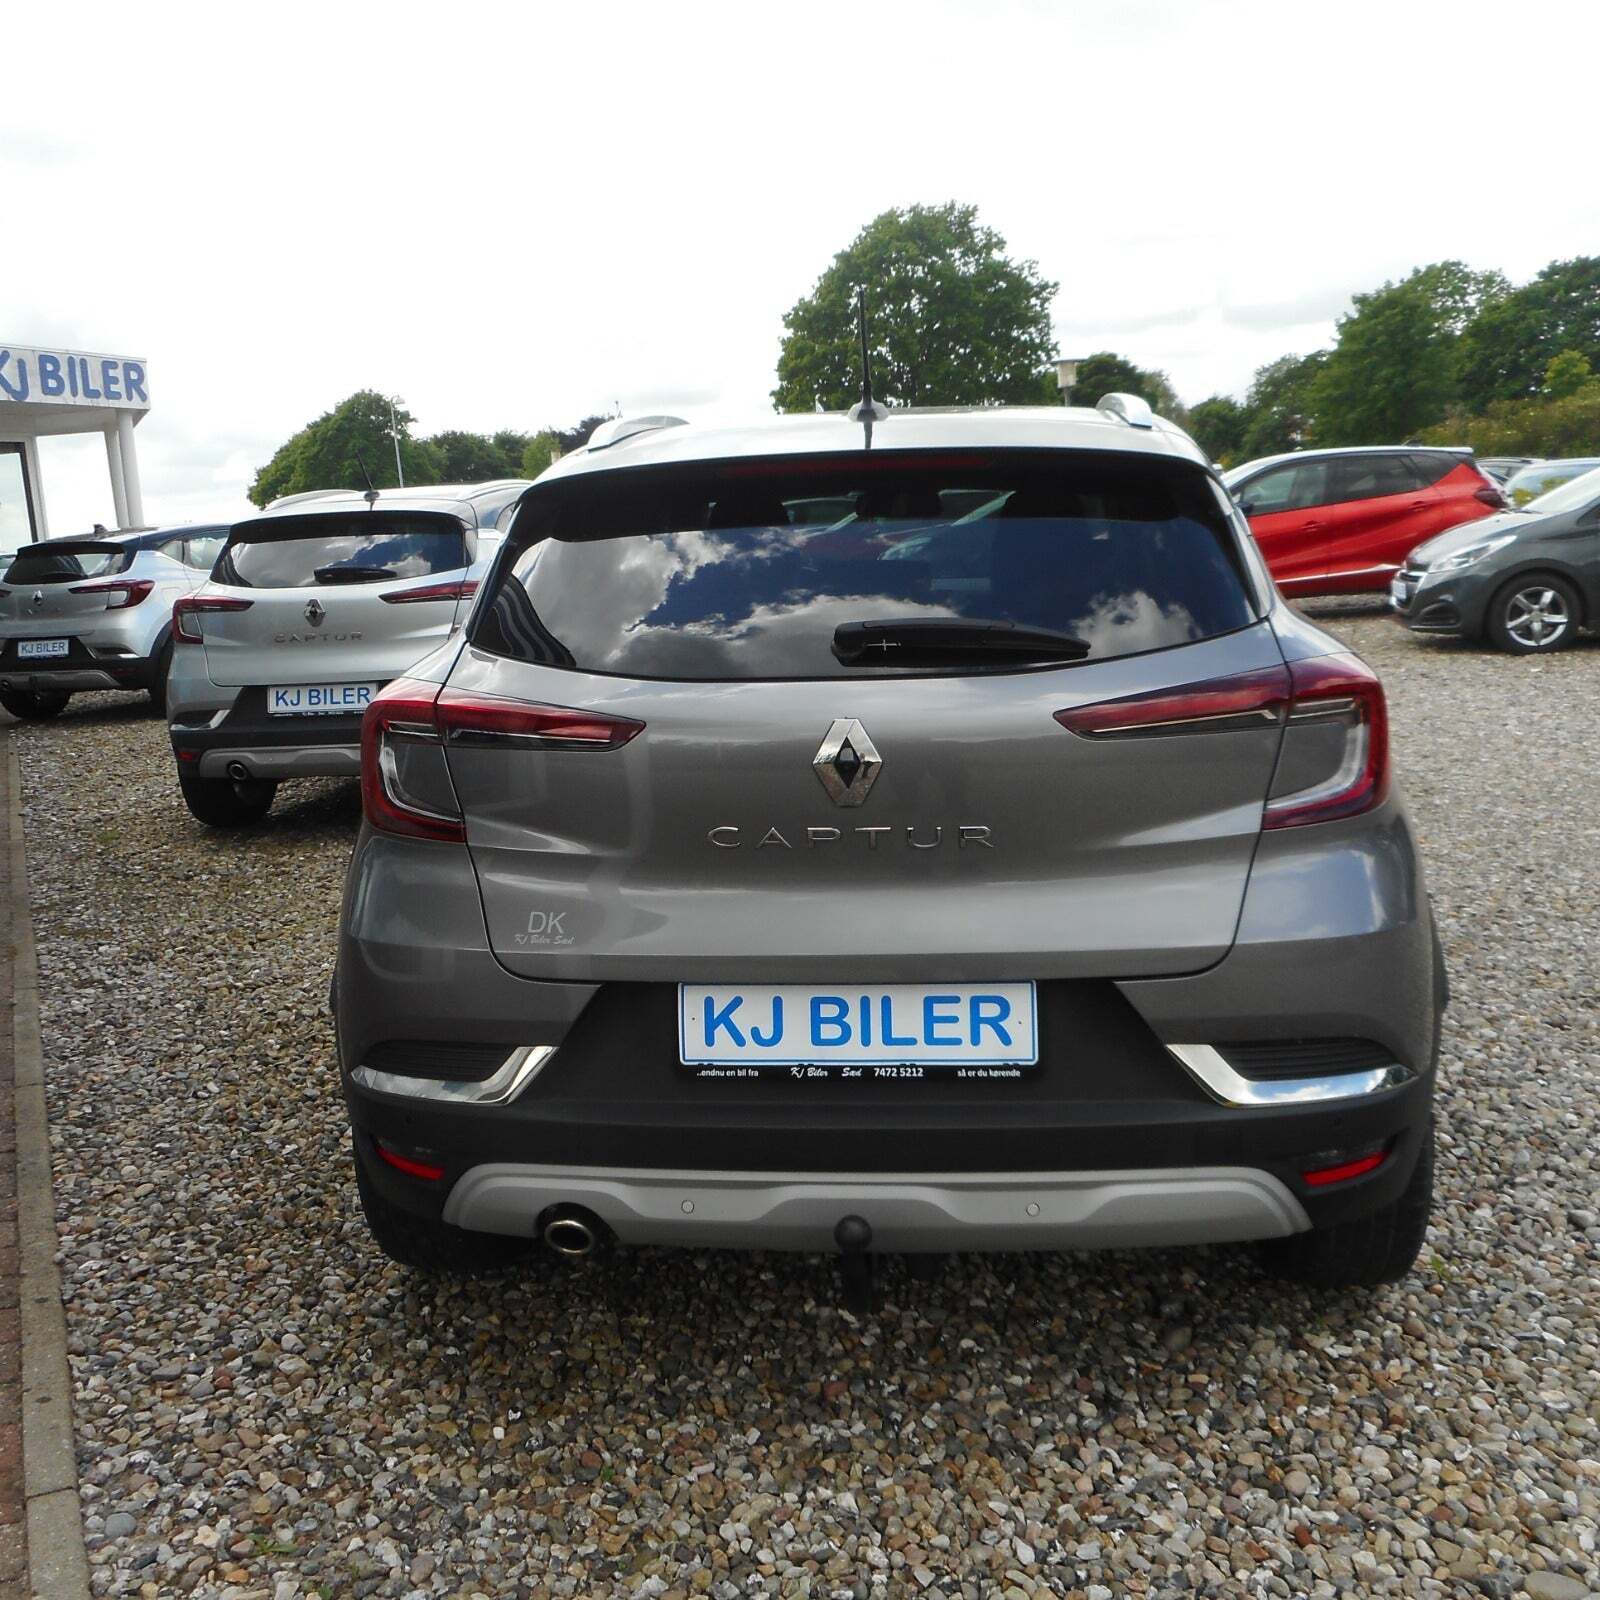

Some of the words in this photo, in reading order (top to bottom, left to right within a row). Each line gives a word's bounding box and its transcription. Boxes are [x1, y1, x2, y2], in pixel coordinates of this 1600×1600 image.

[38, 354, 148, 402] BILER
[21, 643, 34, 654] KJ
[36, 641, 65, 653] BILER
[274, 631, 362, 643] CAPTUR
[275, 689, 301, 707] KJ
[308, 686, 371, 706] BILER
[707, 826, 994, 848] CAPTUR
[528, 911, 567, 933] DK
[703, 995, 784, 1048] KJ
[809, 995, 1013, 1047] BILER
[737, 1068, 747, 1077] bil
[748, 1068, 759, 1077] fra
[807, 1067, 828, 1077] Biler
[873, 1067, 898, 1077] 7472
[899, 1067, 924, 1077] 5212
[957, 1068, 967, 1077] så
[977, 1068, 988, 1077] du
